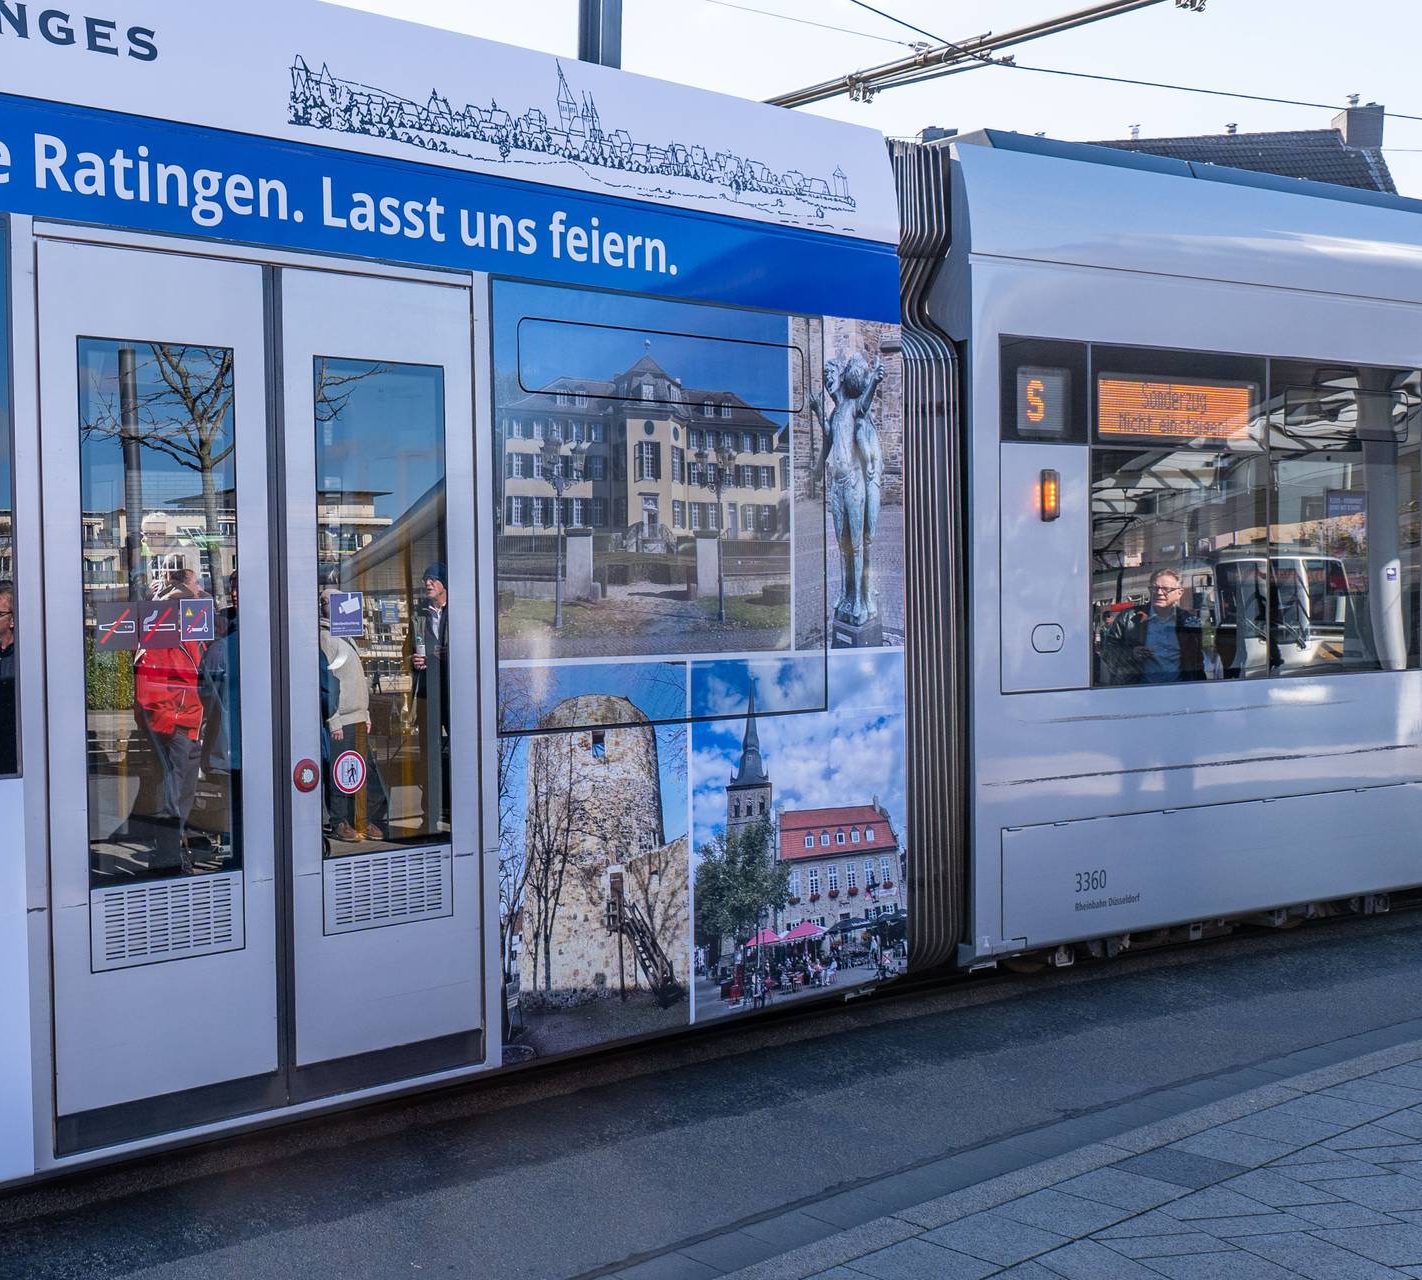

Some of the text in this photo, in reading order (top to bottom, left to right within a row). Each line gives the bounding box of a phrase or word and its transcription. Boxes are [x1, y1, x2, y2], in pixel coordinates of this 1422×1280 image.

[34, 132, 305, 227] Ratingen.
[322, 176, 446, 242] Lasst
[460, 210, 537, 255] uns
[549, 211, 679, 276] feiern.
[1026, 379, 1046, 423] S
[1140, 383, 1208, 414] Sonderzug
[1118, 412, 1153, 433] Nicht
[1074, 869, 1107, 893] 3360
[1074, 892, 1140, 912] Rheinbahn Düsseldorf
